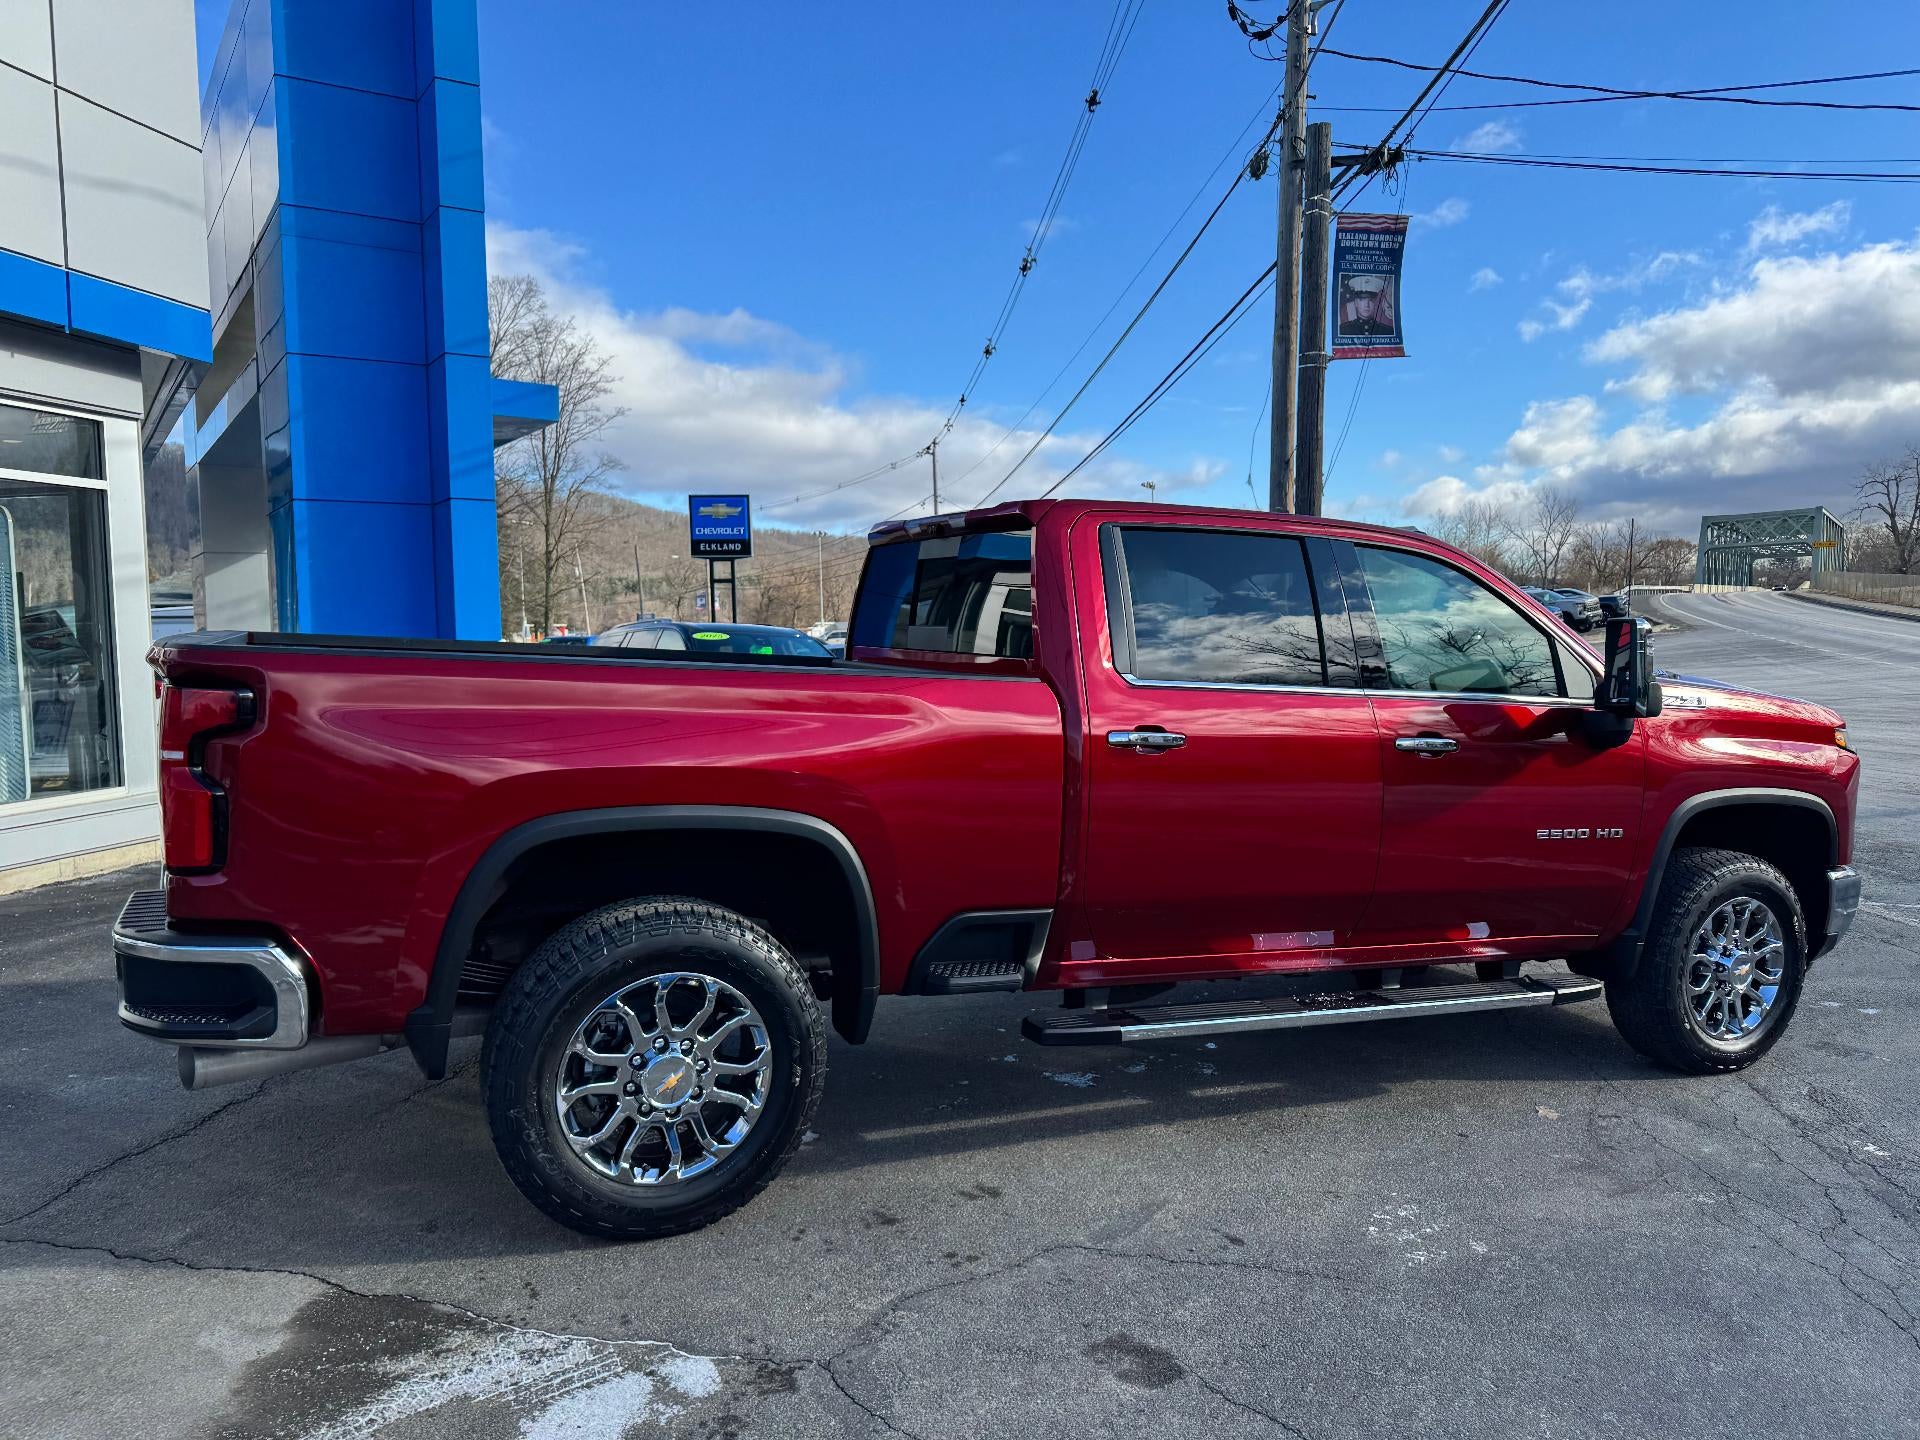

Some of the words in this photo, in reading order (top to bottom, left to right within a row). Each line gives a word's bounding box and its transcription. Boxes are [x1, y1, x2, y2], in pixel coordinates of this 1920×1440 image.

[1338, 232, 1368, 240] ELKLAND
[1369, 233, 1403, 242] BOROUGH
[1341, 239, 1379, 248] HOMETOWN
[1380, 241, 1400, 249] HERO
[695, 527, 745, 535] CHEVROLET
[700, 543, 742, 551] ELKLAND
[1536, 828, 1590, 840] 2500
[1596, 828, 1624, 839] HD
